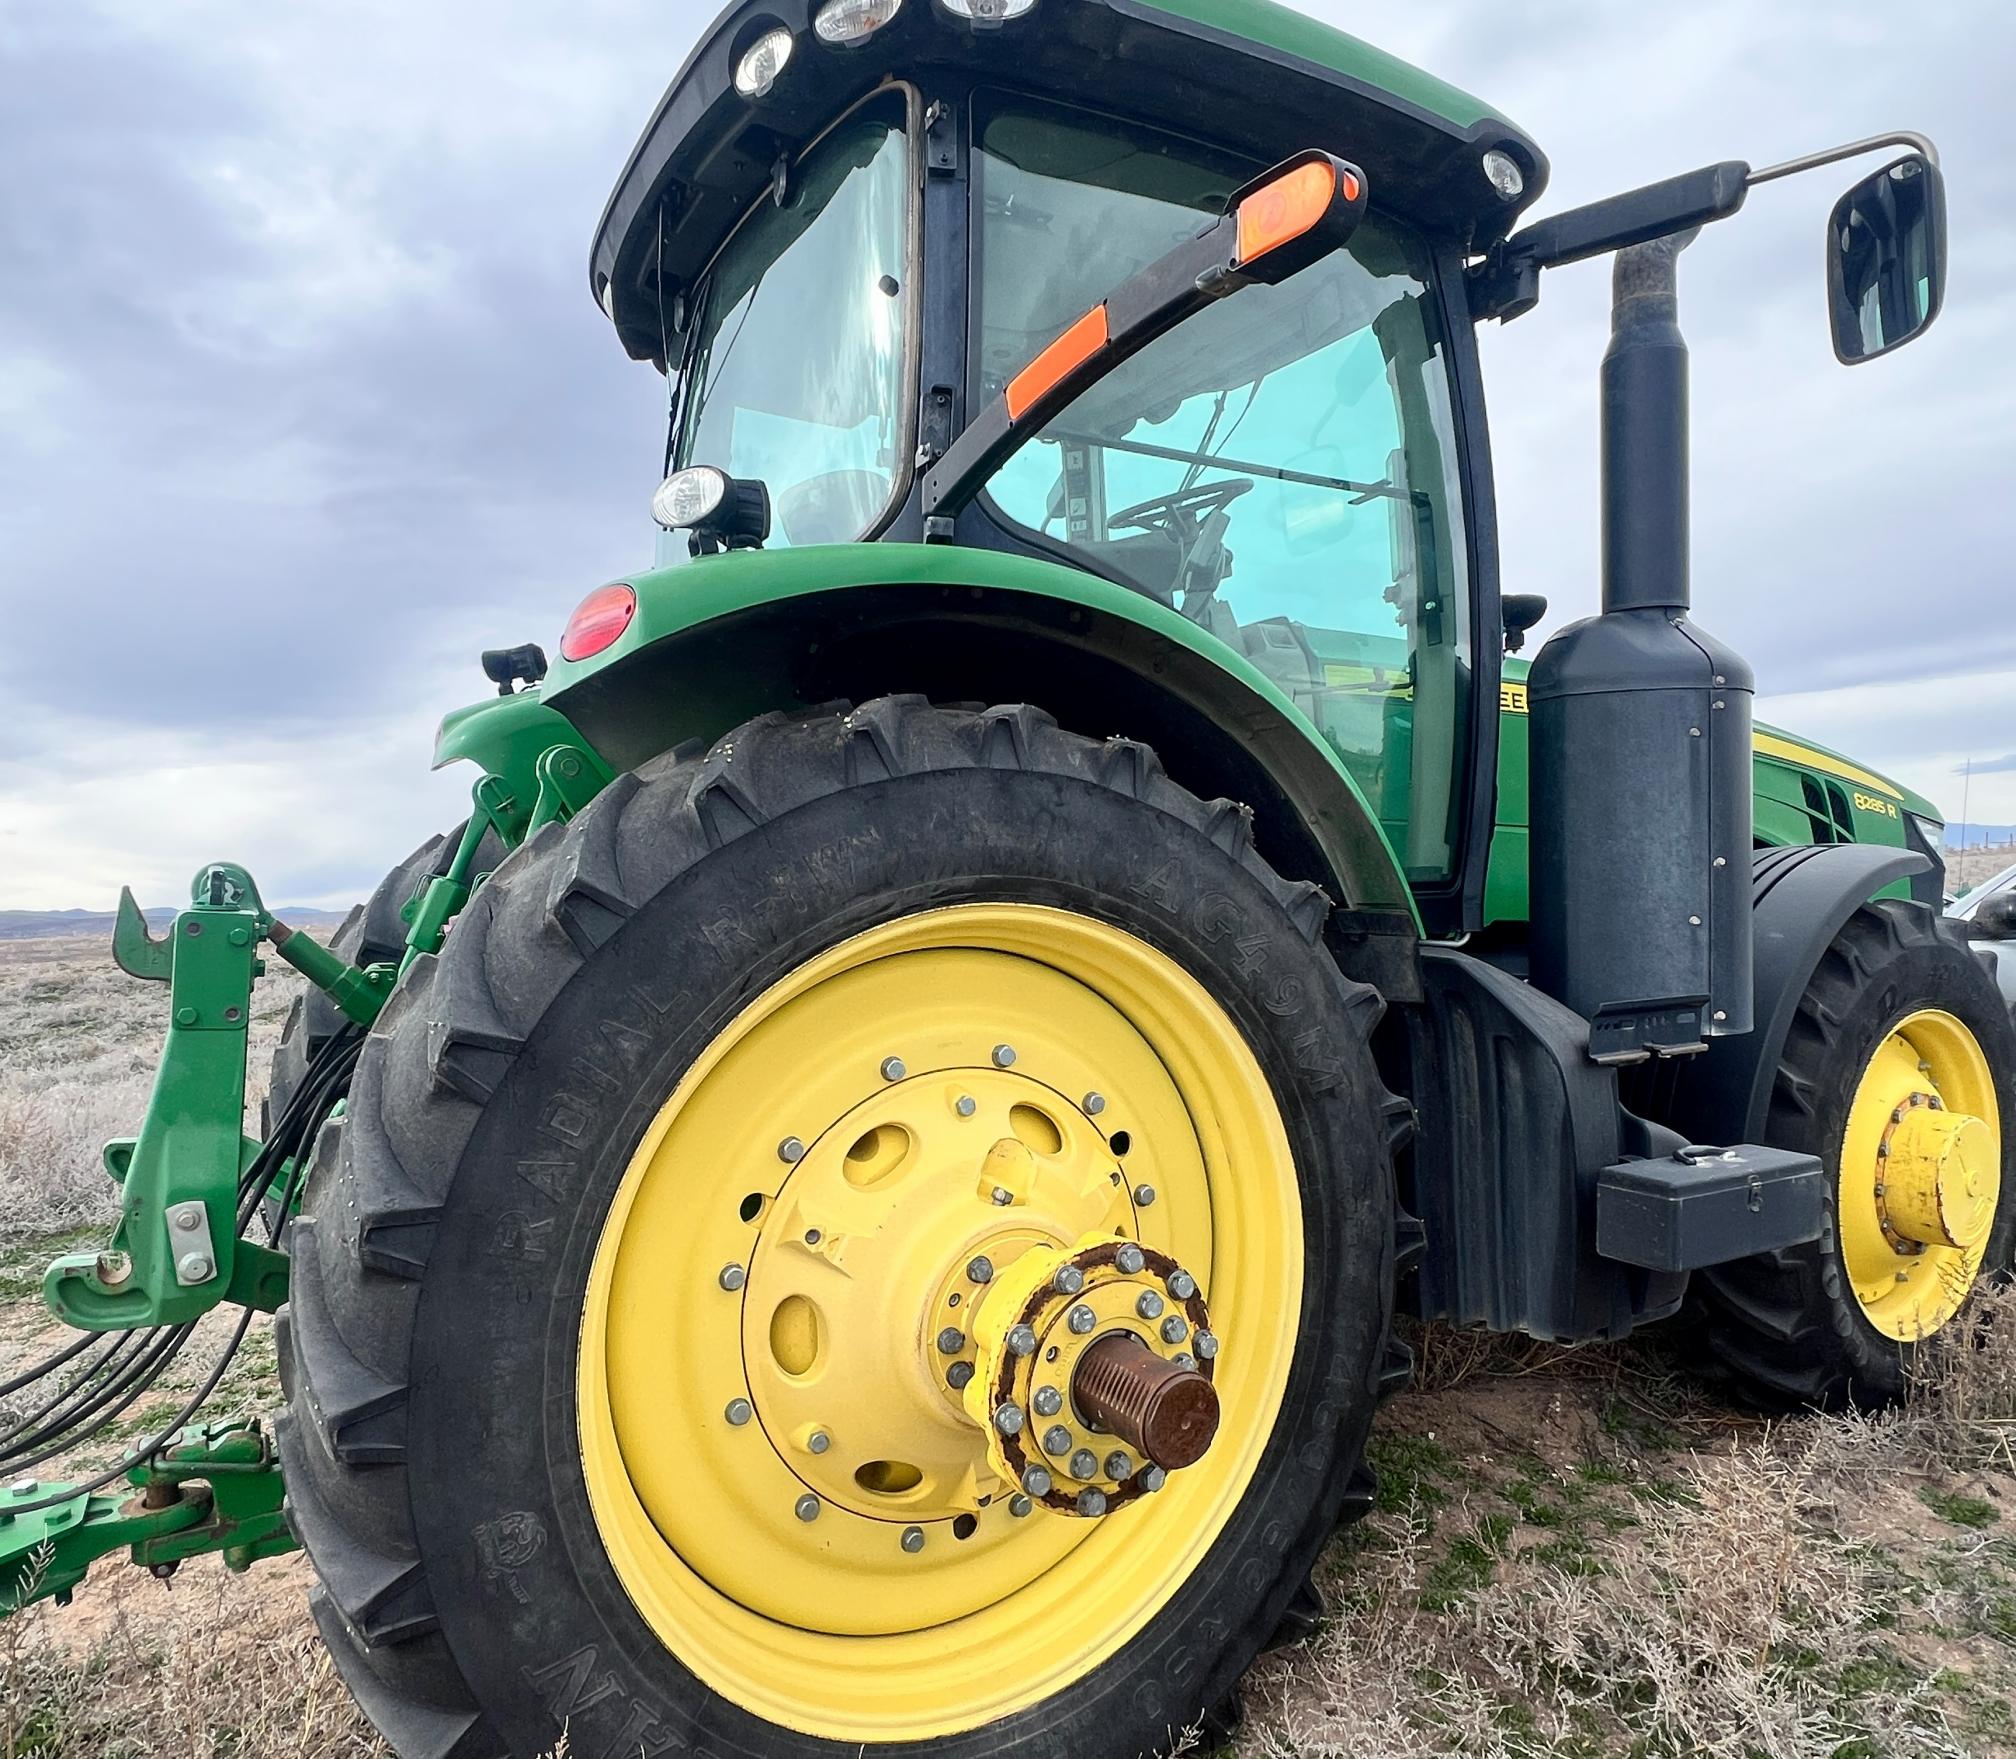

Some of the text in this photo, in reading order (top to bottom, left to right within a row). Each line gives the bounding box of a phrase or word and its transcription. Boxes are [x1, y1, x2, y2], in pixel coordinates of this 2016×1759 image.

[1853, 792, 1886, 814] 8285
[486, 984, 692, 1263] RADIAL
[521, 1642, 722, 1759] AN
